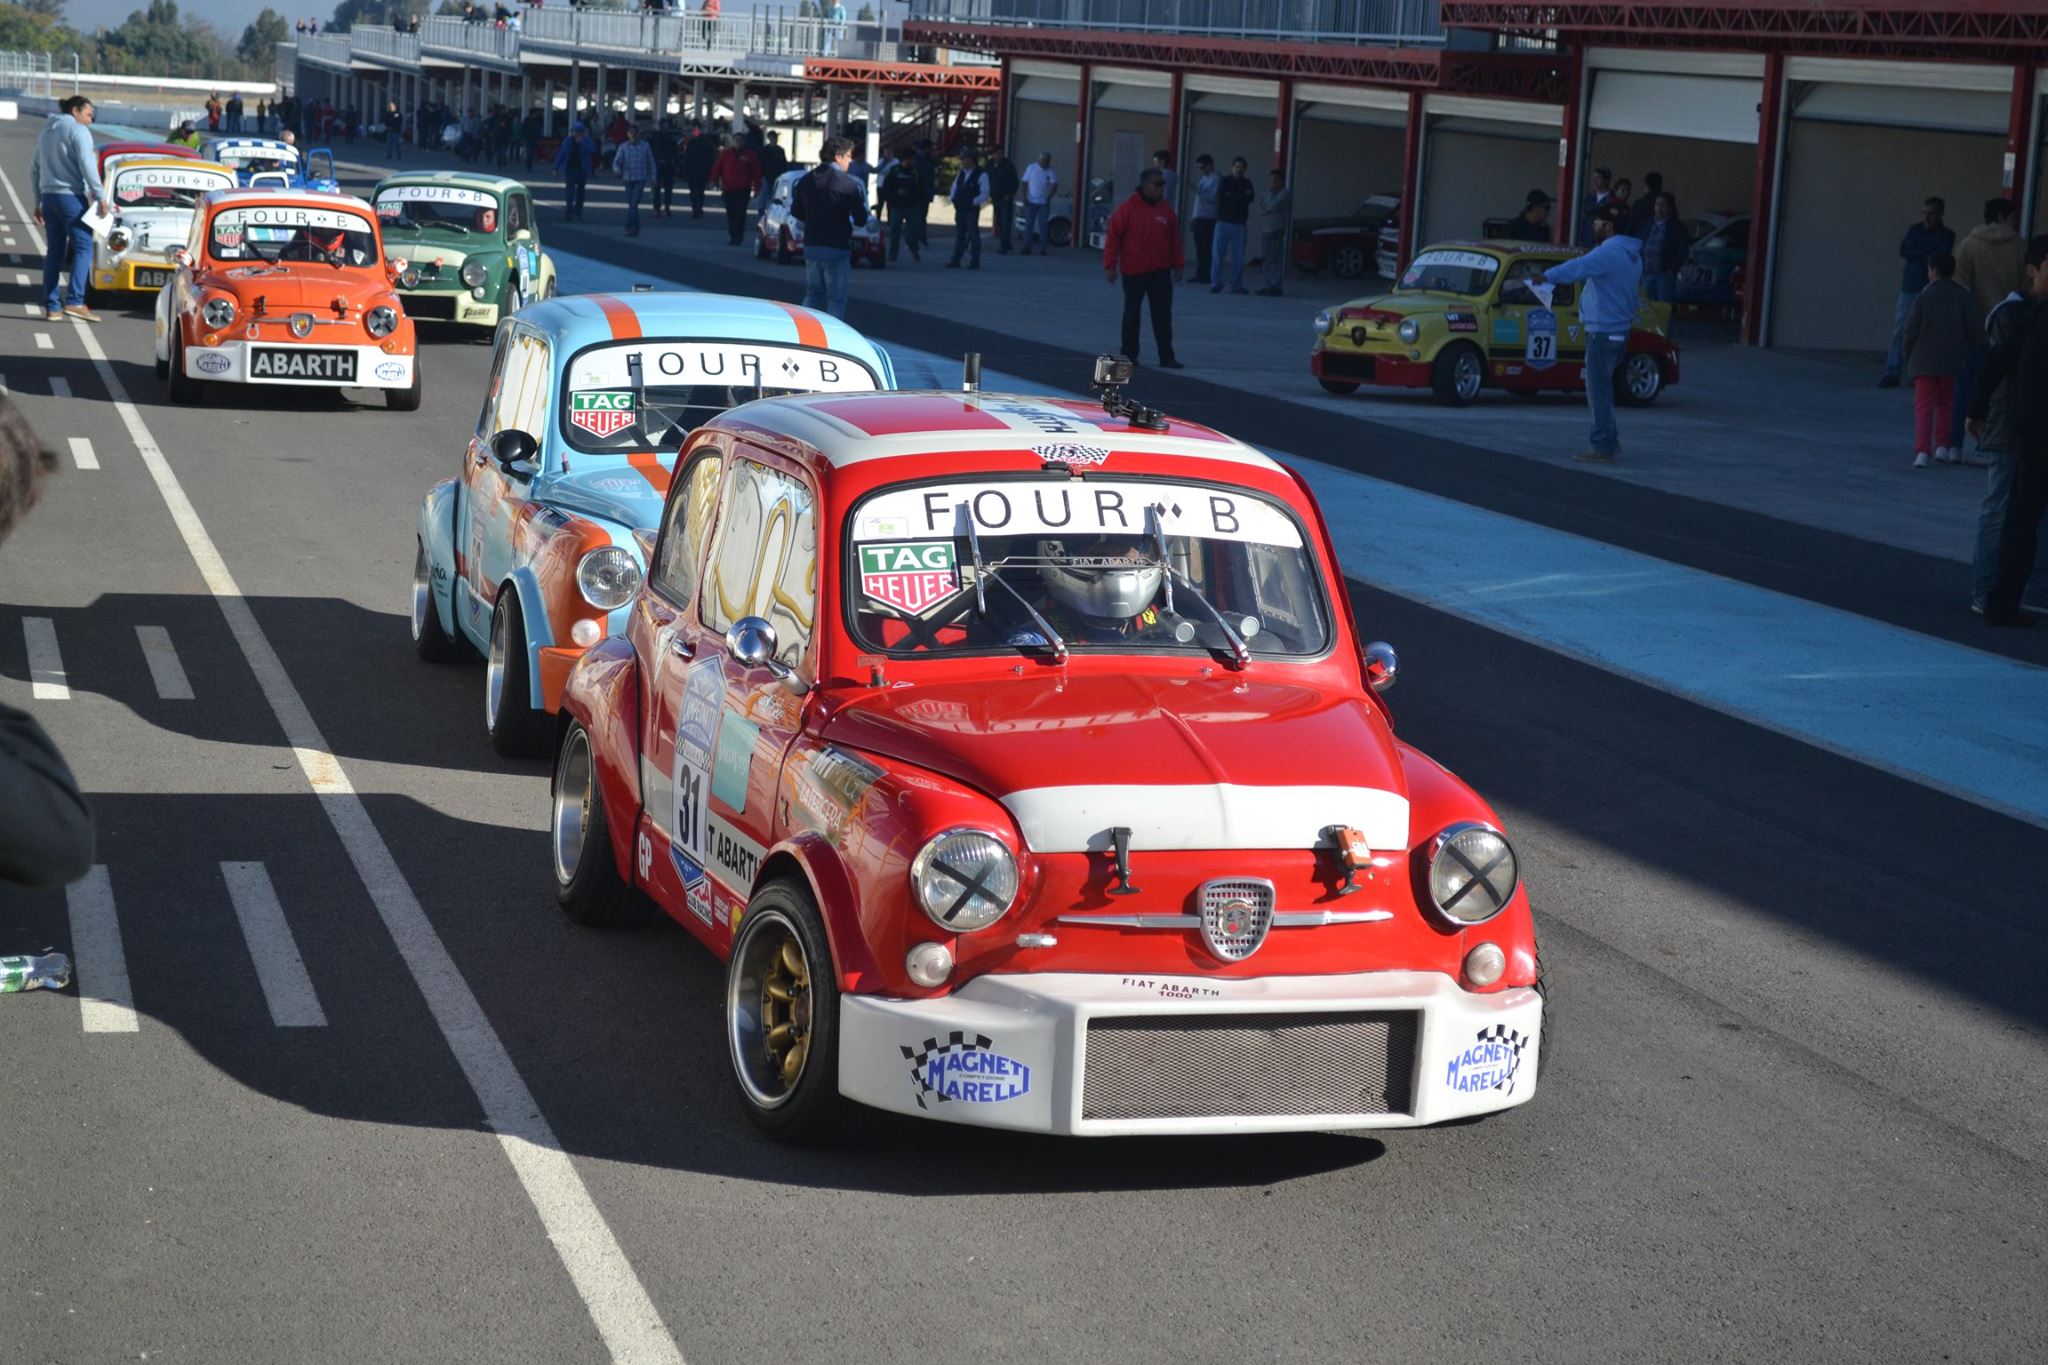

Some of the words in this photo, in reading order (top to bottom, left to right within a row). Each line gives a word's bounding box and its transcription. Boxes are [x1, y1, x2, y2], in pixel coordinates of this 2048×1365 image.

[135, 174, 186, 184] FOUR
[207, 178, 216, 188] B
[398, 187, 452, 198] FOUR
[473, 192, 482, 202] B
[238, 210, 307, 224] FOUR
[1533, 336, 1551, 358] 37
[254, 352, 355, 377] ABARTH
[626, 352, 763, 377] FOUR
[819, 359, 841, 384] B
[577, 392, 633, 410] TAG
[574, 410, 634, 436] HEUER
[923, 489, 1130, 531] FOUR
[1209, 495, 1241, 534] B
[867, 546, 948, 571] TAG
[1072, 557, 1095, 567] FIAT
[1101, 557, 1146, 567] ABARTH
[868, 574, 953, 609] HEUER
[678, 762, 701, 854] 31
[638, 831, 653, 882] GP
[1122, 977, 1156, 989] FIAT
[1161, 982, 1220, 997] ABARTH
[1158, 990, 1193, 999] 1000
[928, 1051, 1031, 1086] MAGNETI
[1446, 1043, 1513, 1079] MAGNETI
